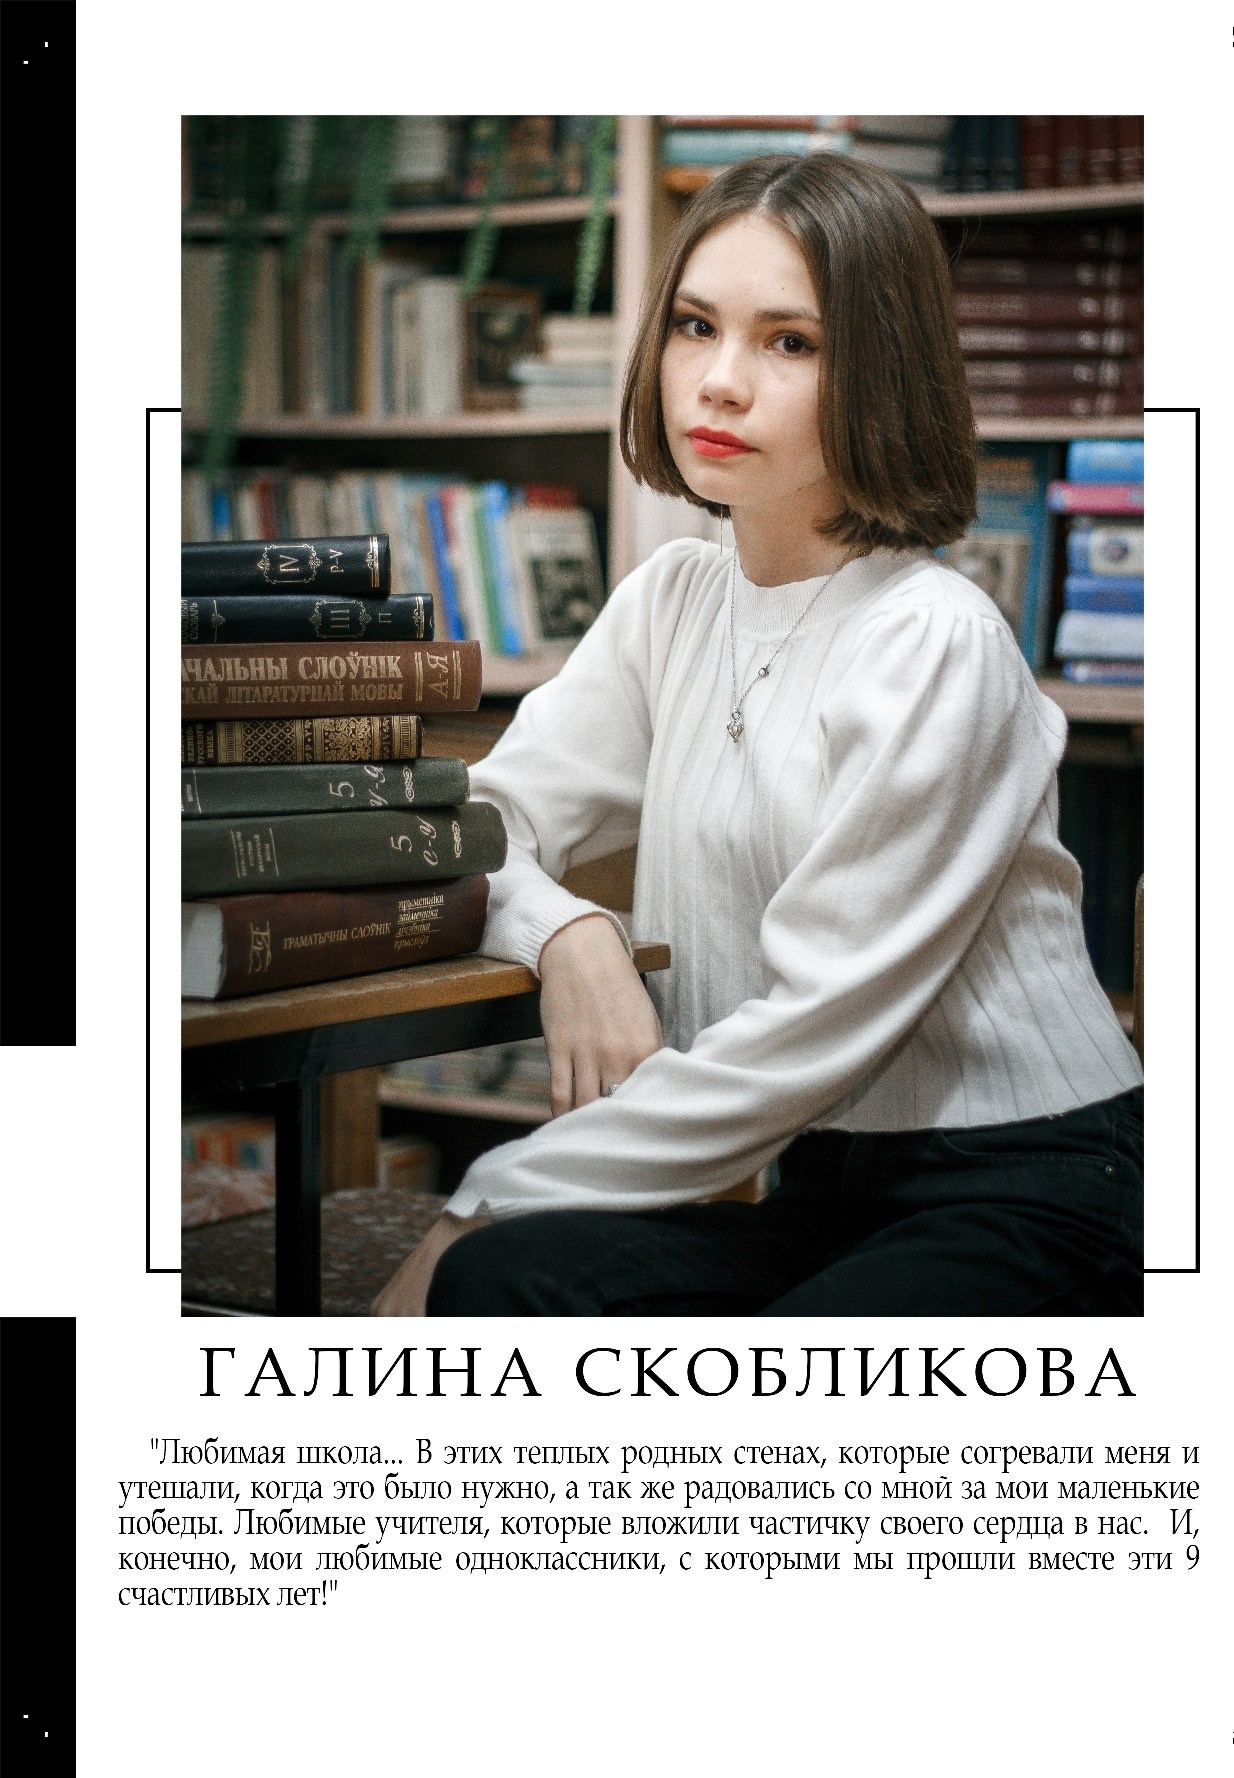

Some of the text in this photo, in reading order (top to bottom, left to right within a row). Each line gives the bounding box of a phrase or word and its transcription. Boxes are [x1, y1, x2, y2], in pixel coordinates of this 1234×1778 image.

[279, 554, 300, 573] IV
[299, 651, 403, 681] СЛОЎНІК
[227, 681, 345, 703] ЛІТАРАТУРНАЙ
[351, 683, 403, 701] МОВЫ
[328, 781, 355, 798] 5
[390, 835, 413, 853] 5
[283, 922, 391, 950] ГРАМАТЫЧНЫ СЛОЎНІК
